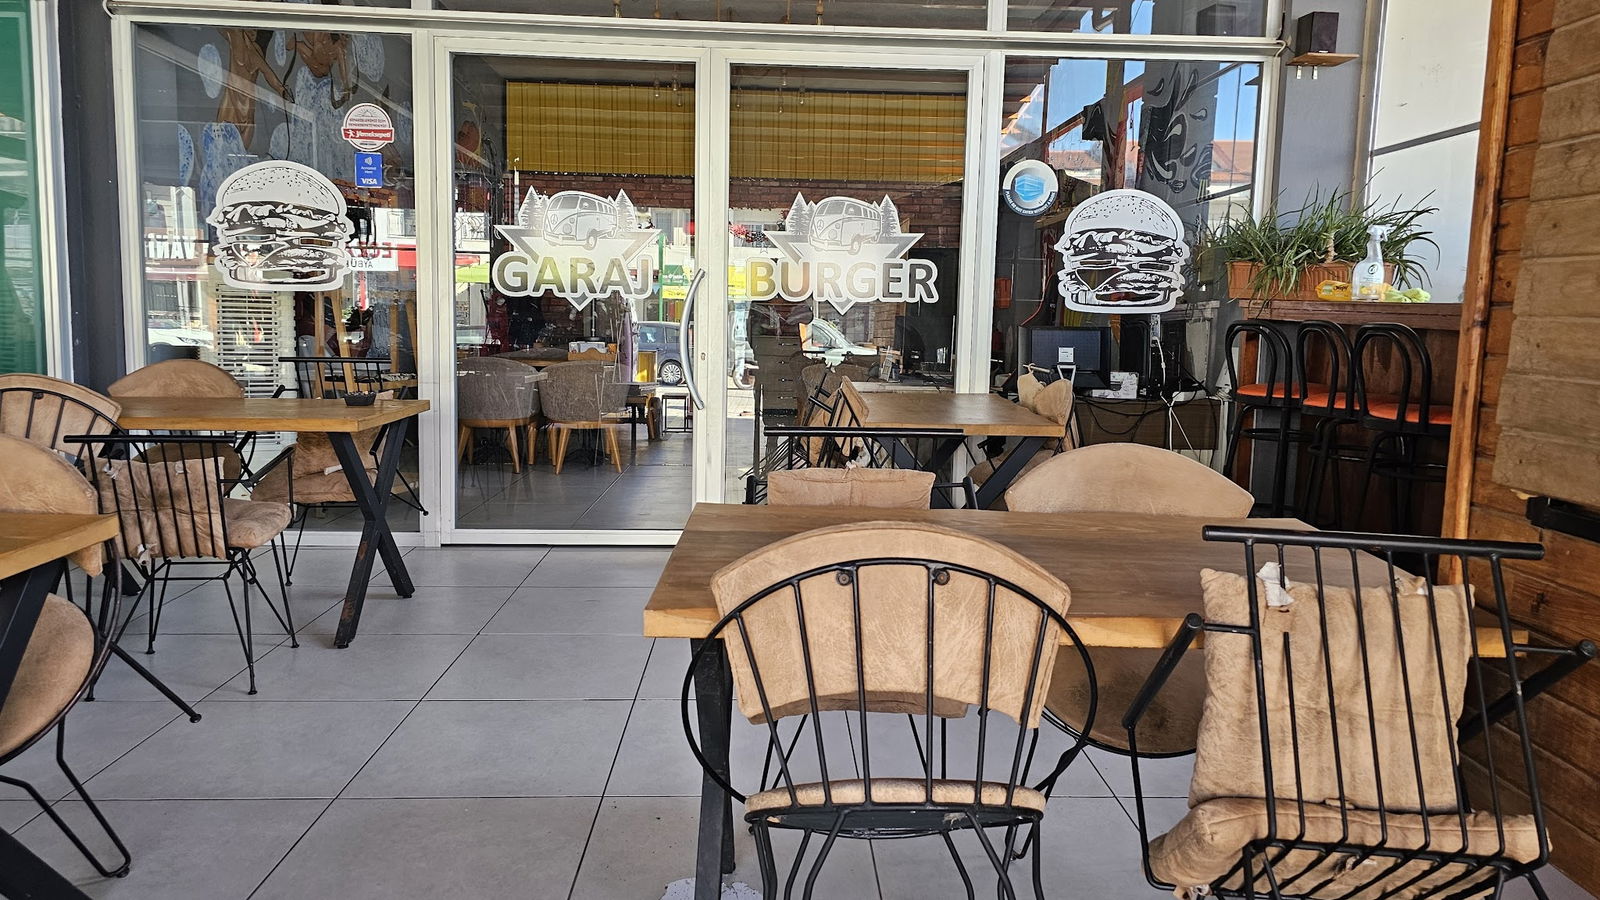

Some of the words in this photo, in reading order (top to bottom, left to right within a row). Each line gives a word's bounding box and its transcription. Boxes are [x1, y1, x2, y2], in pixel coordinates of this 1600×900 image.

[360, 177, 378, 185] VISA
[496, 255, 650, 295] GARAJ
[750, 261, 935, 299] BURGER
